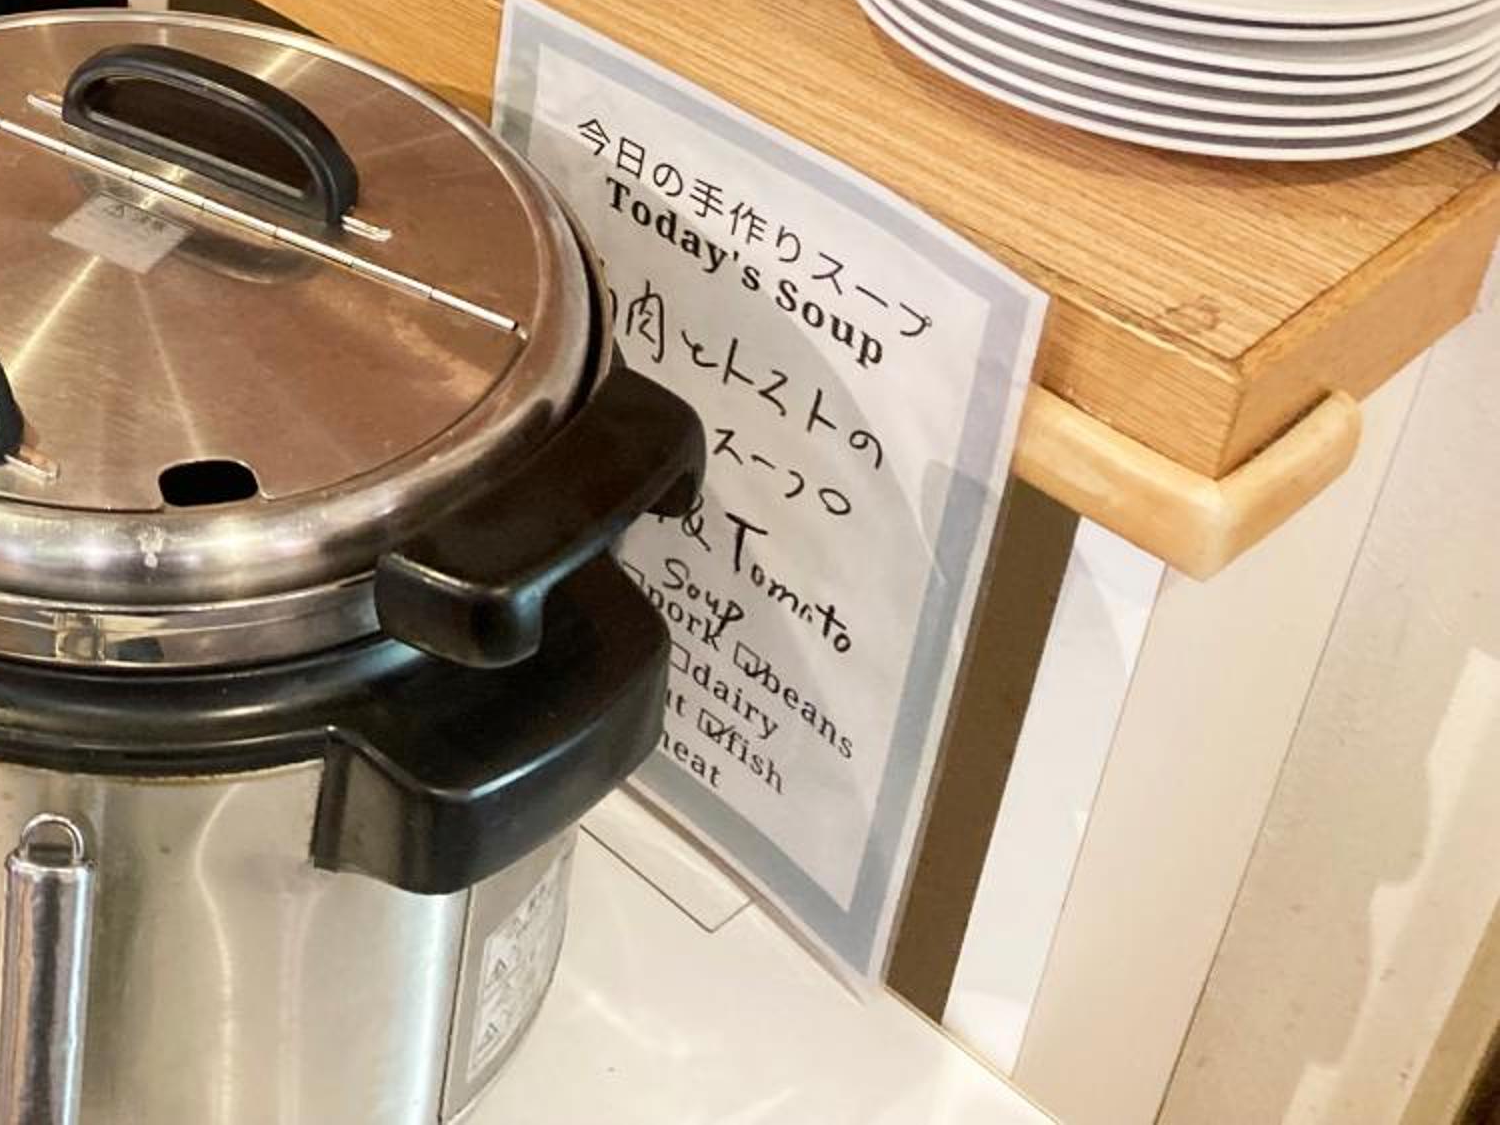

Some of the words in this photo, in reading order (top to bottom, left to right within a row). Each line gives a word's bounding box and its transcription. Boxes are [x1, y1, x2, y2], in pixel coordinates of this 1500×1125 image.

[577, 117, 932, 338] 今日の手作りスープ
[606, 176, 761, 292] Today's
[774, 279, 884, 370] Soup
[662, 557, 745, 635] Soup
[692, 663, 779, 741] dairy
[760, 661, 854, 760] beans
[724, 728, 784, 795] fish
